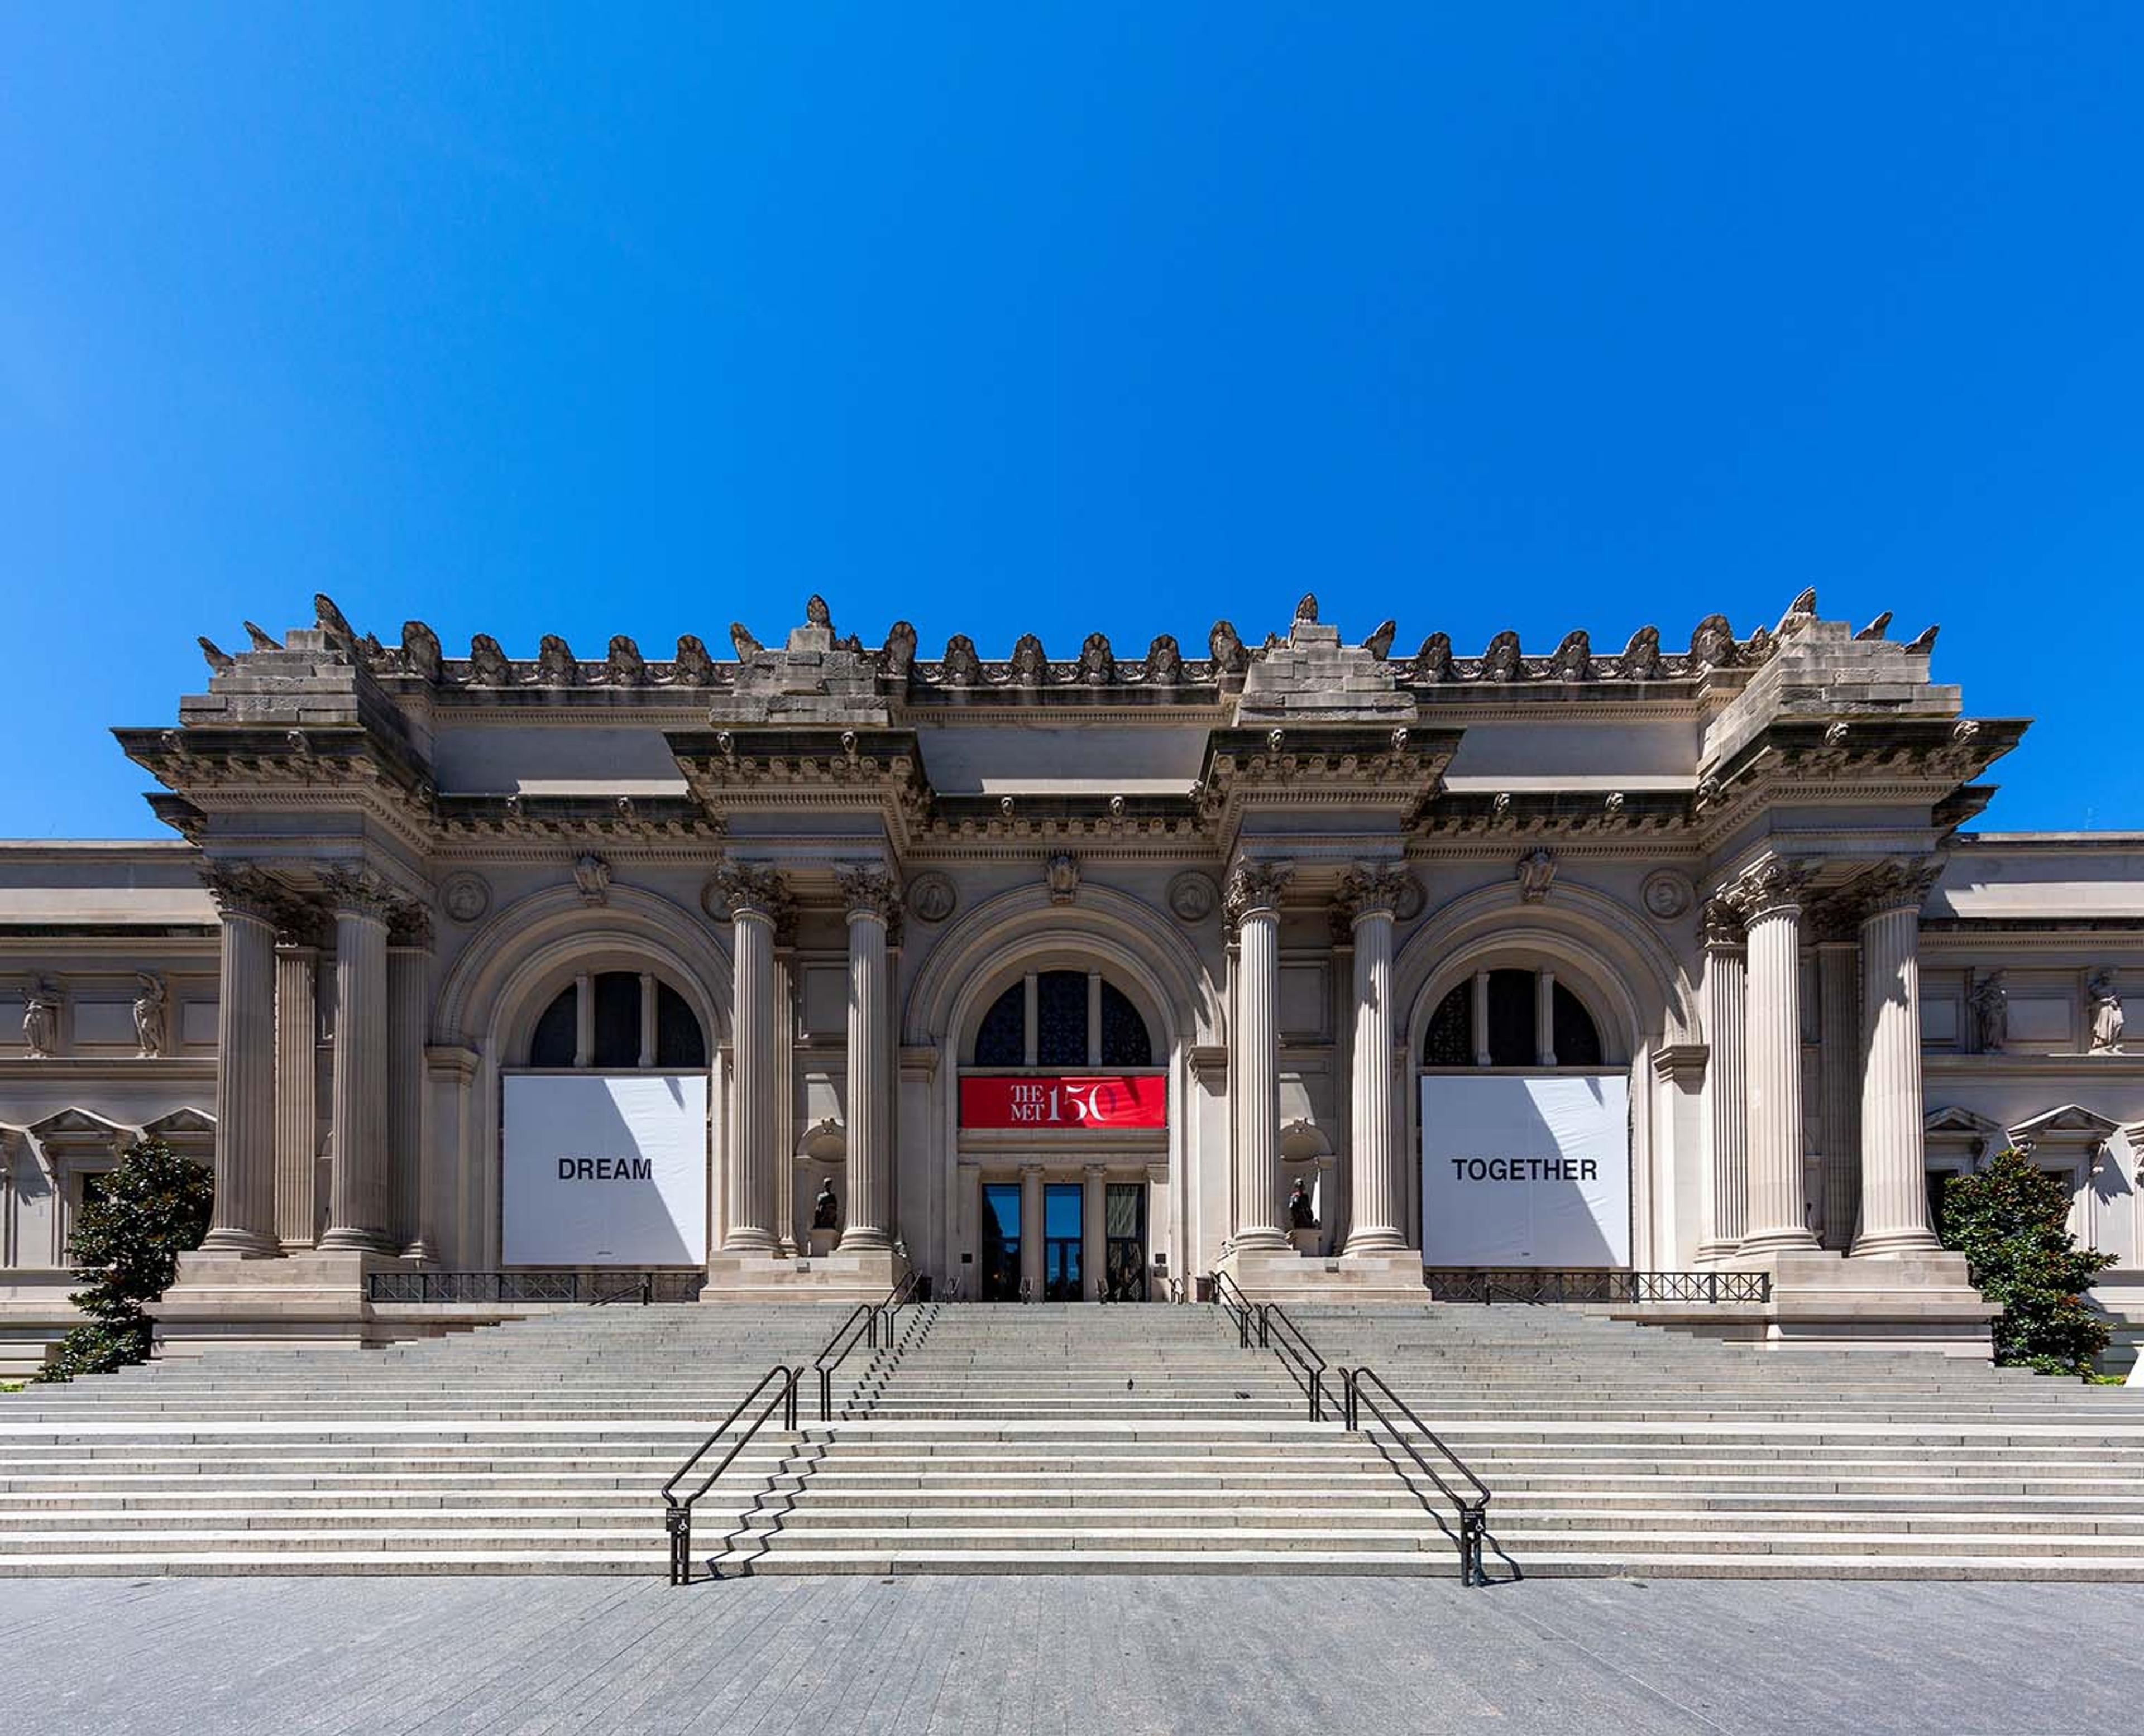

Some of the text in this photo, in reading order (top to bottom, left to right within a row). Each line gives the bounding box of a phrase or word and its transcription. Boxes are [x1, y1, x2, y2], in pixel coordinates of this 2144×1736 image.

[1010, 1085, 1044, 1102] THE
[1047, 1084, 1117, 1121] 150
[1011, 1104, 1045, 1121] MET
[558, 1158, 652, 1180] DREAM
[1451, 1158, 1597, 1181] TOGETHER
